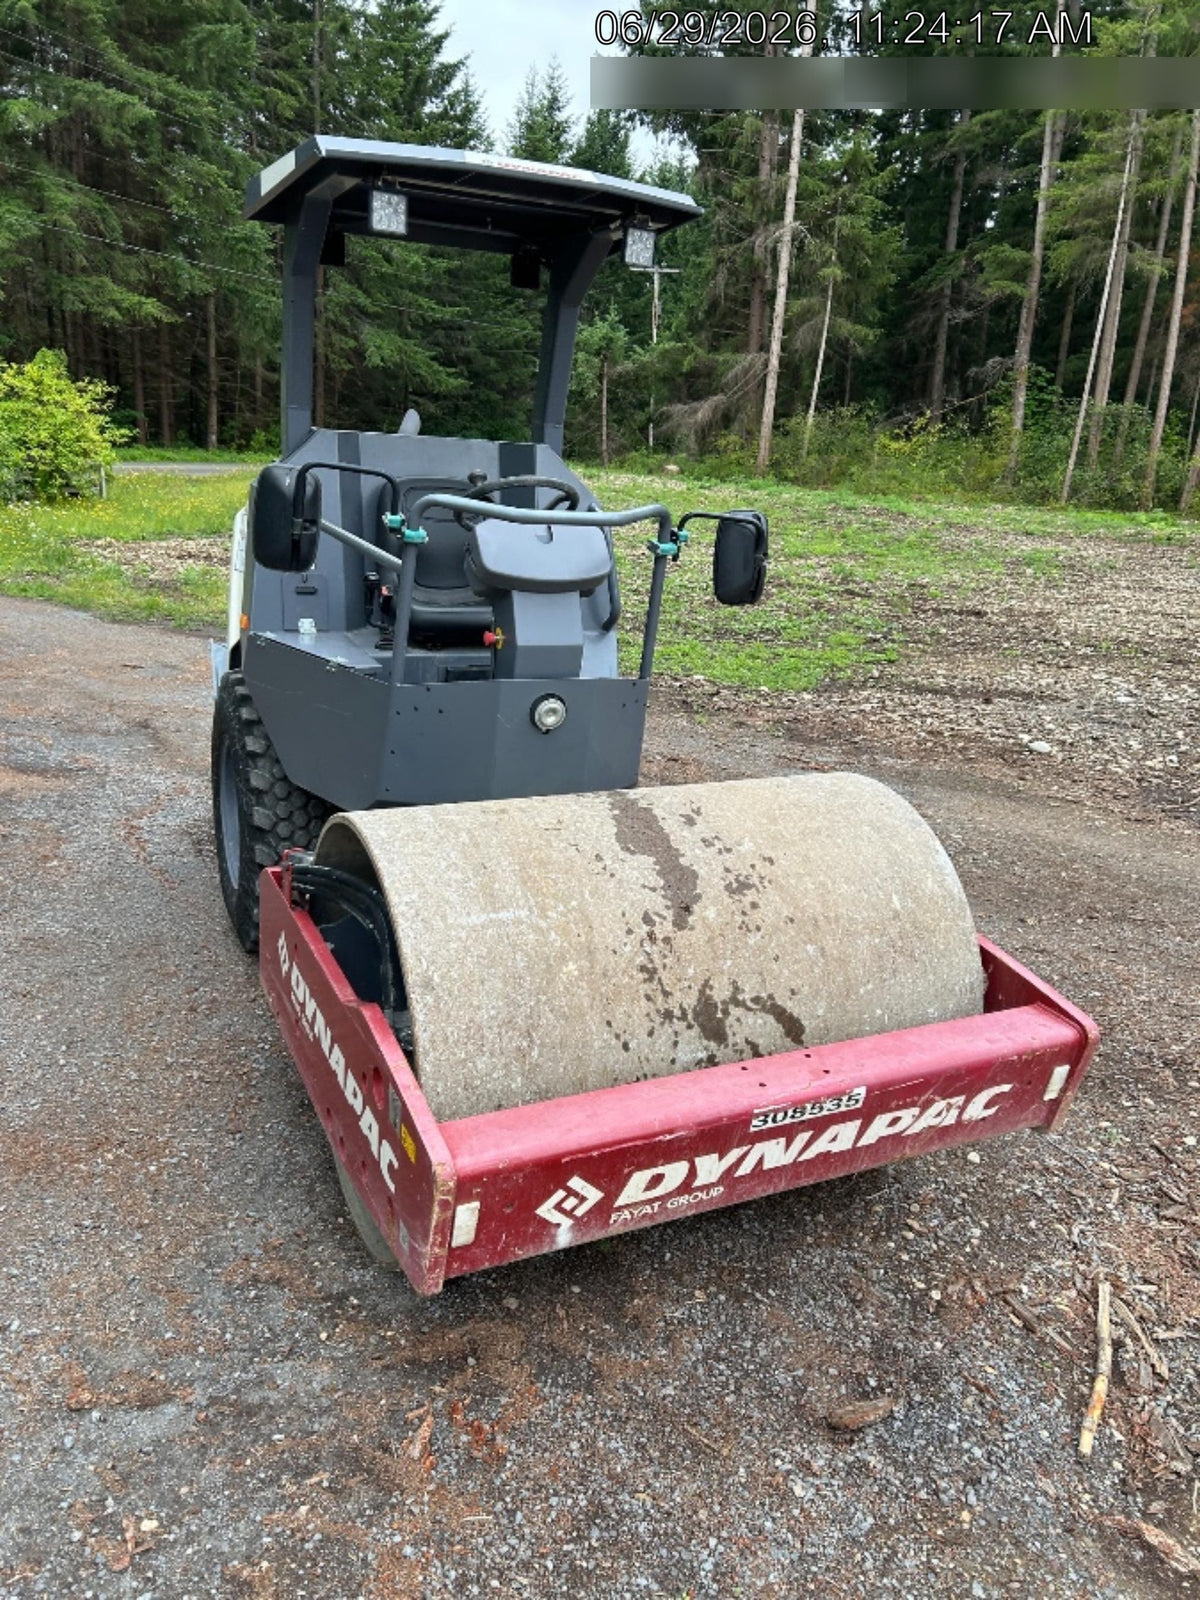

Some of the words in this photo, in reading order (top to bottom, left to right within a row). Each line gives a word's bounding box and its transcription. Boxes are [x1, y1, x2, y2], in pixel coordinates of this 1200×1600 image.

[290, 961, 399, 1194] DYNAPAC
[751, 1092, 863, 1129] 308535
[613, 1083, 1013, 1208] DYNAPAC
[609, 1201, 662, 1224] FAYAT
[666, 1186, 725, 1209] GROUP
